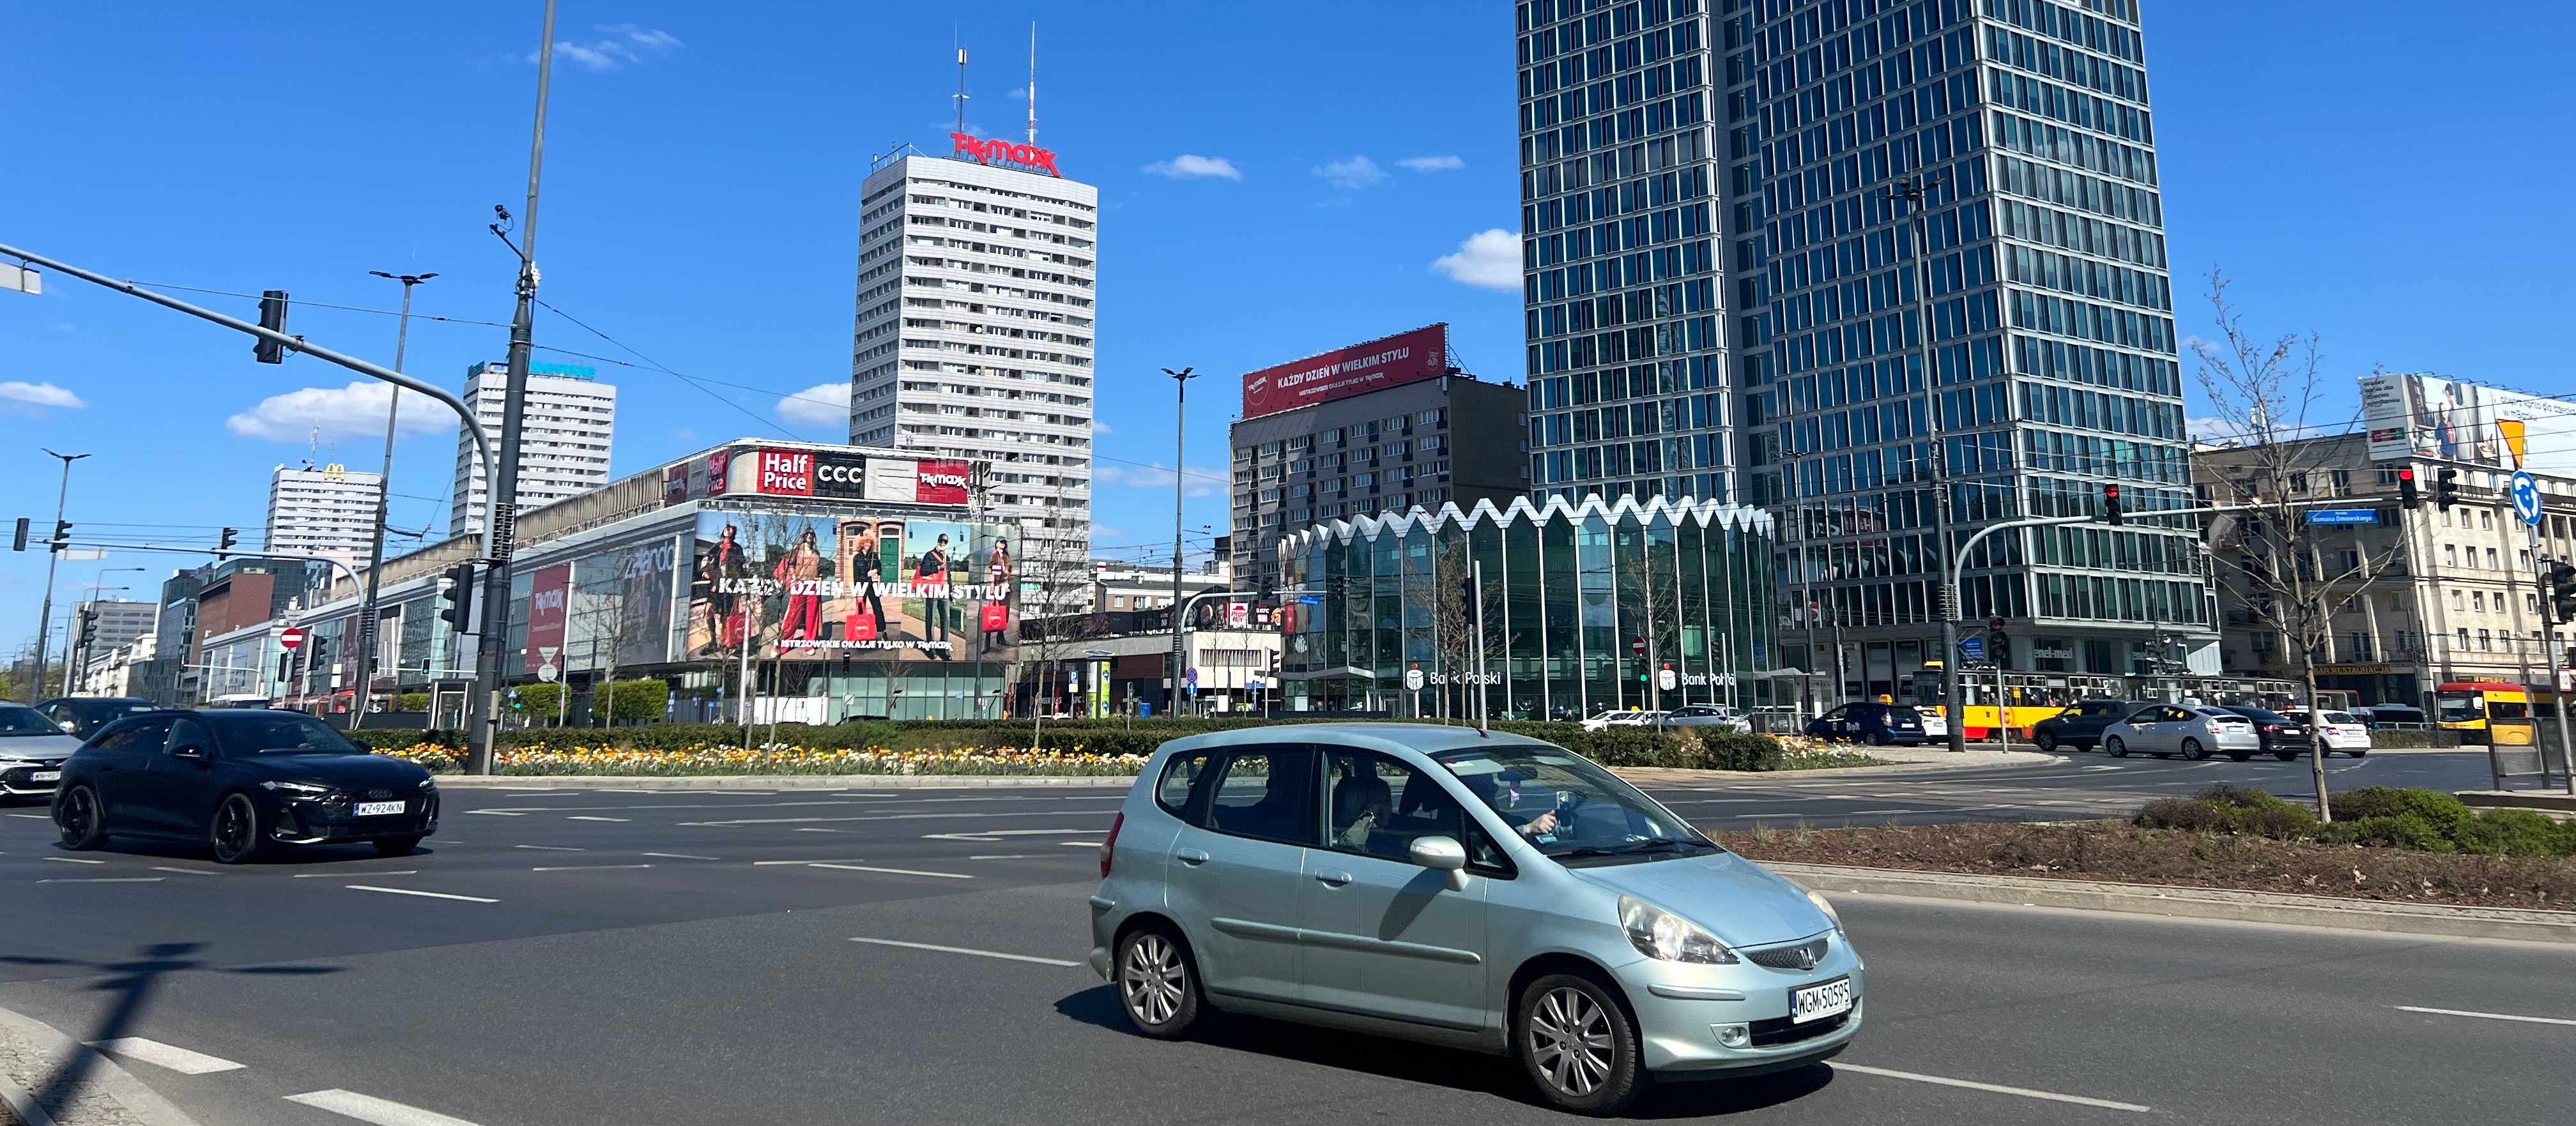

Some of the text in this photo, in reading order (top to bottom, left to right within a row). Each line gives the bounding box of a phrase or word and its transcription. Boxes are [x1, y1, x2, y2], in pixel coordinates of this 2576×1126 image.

[1278, 346, 1409, 389] KAŻDY DZIEŃ W WIELKIM STYLU
[765, 453, 808, 474] Half
[764, 471, 806, 490] Price
[818, 465, 862, 483] CCC
[790, 577, 844, 596] DZIEŃ
[848, 581, 869, 597] W
[873, 582, 949, 599] WIELKIM
[953, 584, 1007, 600] STYLU
[841, 640, 876, 649] OKAZJE
[877, 640, 905, 650] TYLKO
[905, 641, 915, 649] W
[2034, 646, 2073, 659] enel-med
[1430, 671, 1460, 685] Bak
[1465, 671, 1501, 685] Poski
[2331, 666, 2389, 674] RESTAURACJA
[1682, 672, 1706, 685] Bank
[1710, 672, 1735, 686] Polki
[361, 803, 402, 814] WZ 924KN
[1798, 982, 1850, 1016] WGM 50595
